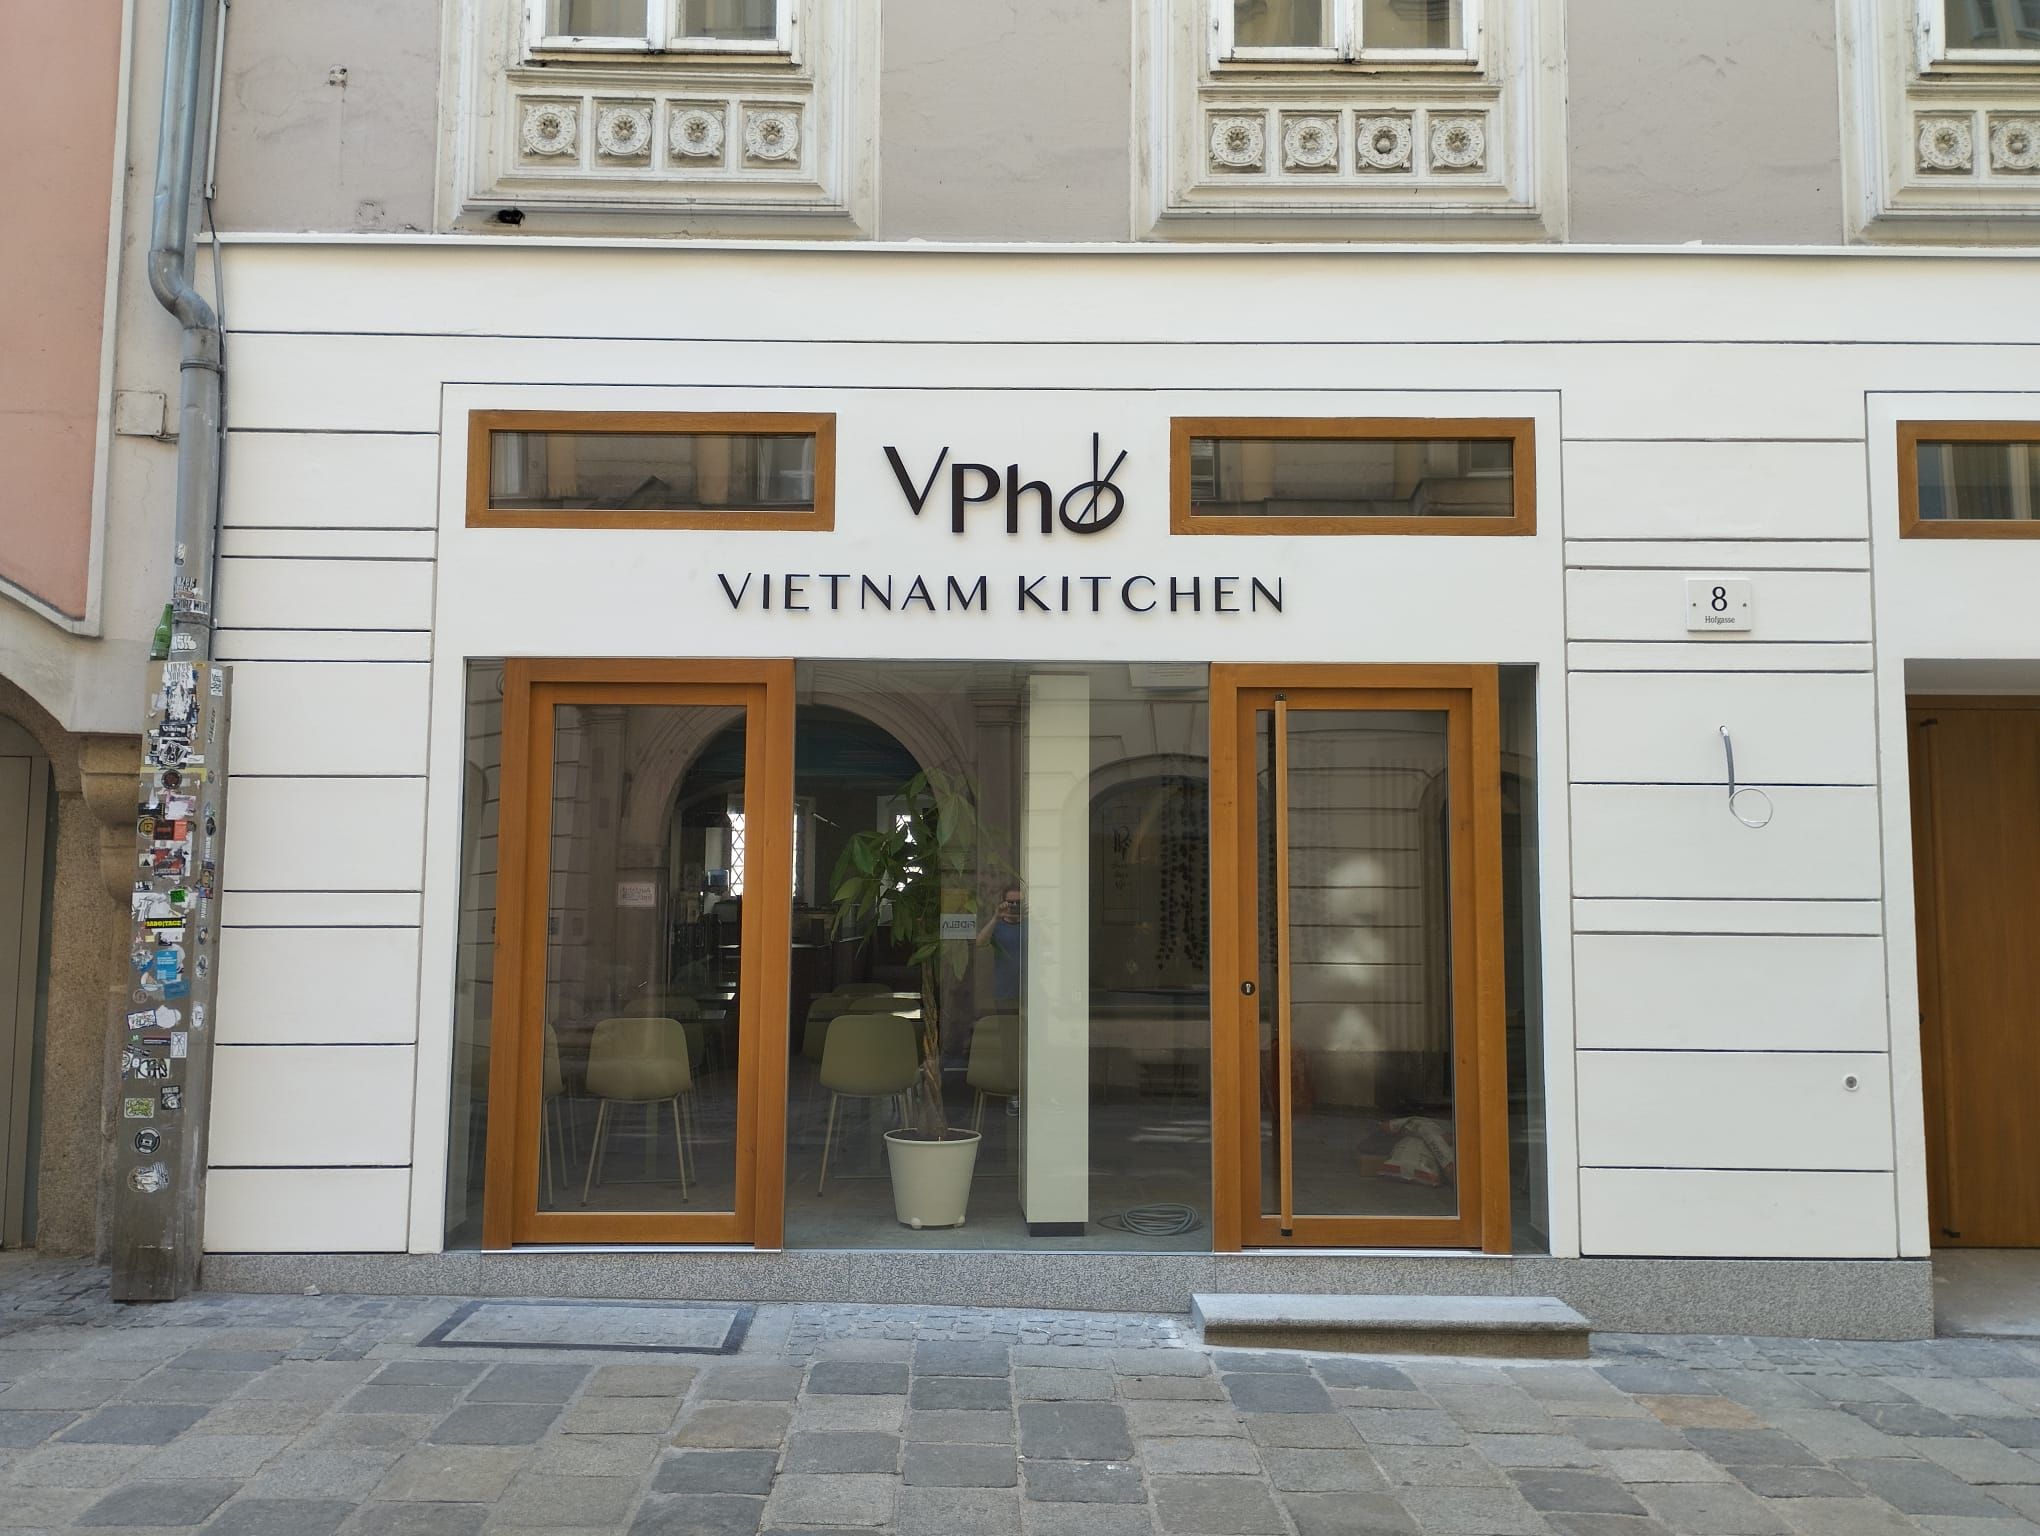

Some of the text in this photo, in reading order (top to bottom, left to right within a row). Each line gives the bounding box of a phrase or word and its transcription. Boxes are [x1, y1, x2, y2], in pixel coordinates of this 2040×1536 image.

[718, 573, 1282, 613] VIETNAM KITCHEN
[1712, 587, 1728, 612] 8
[1705, 616, 1735, 625] Hofgasse
